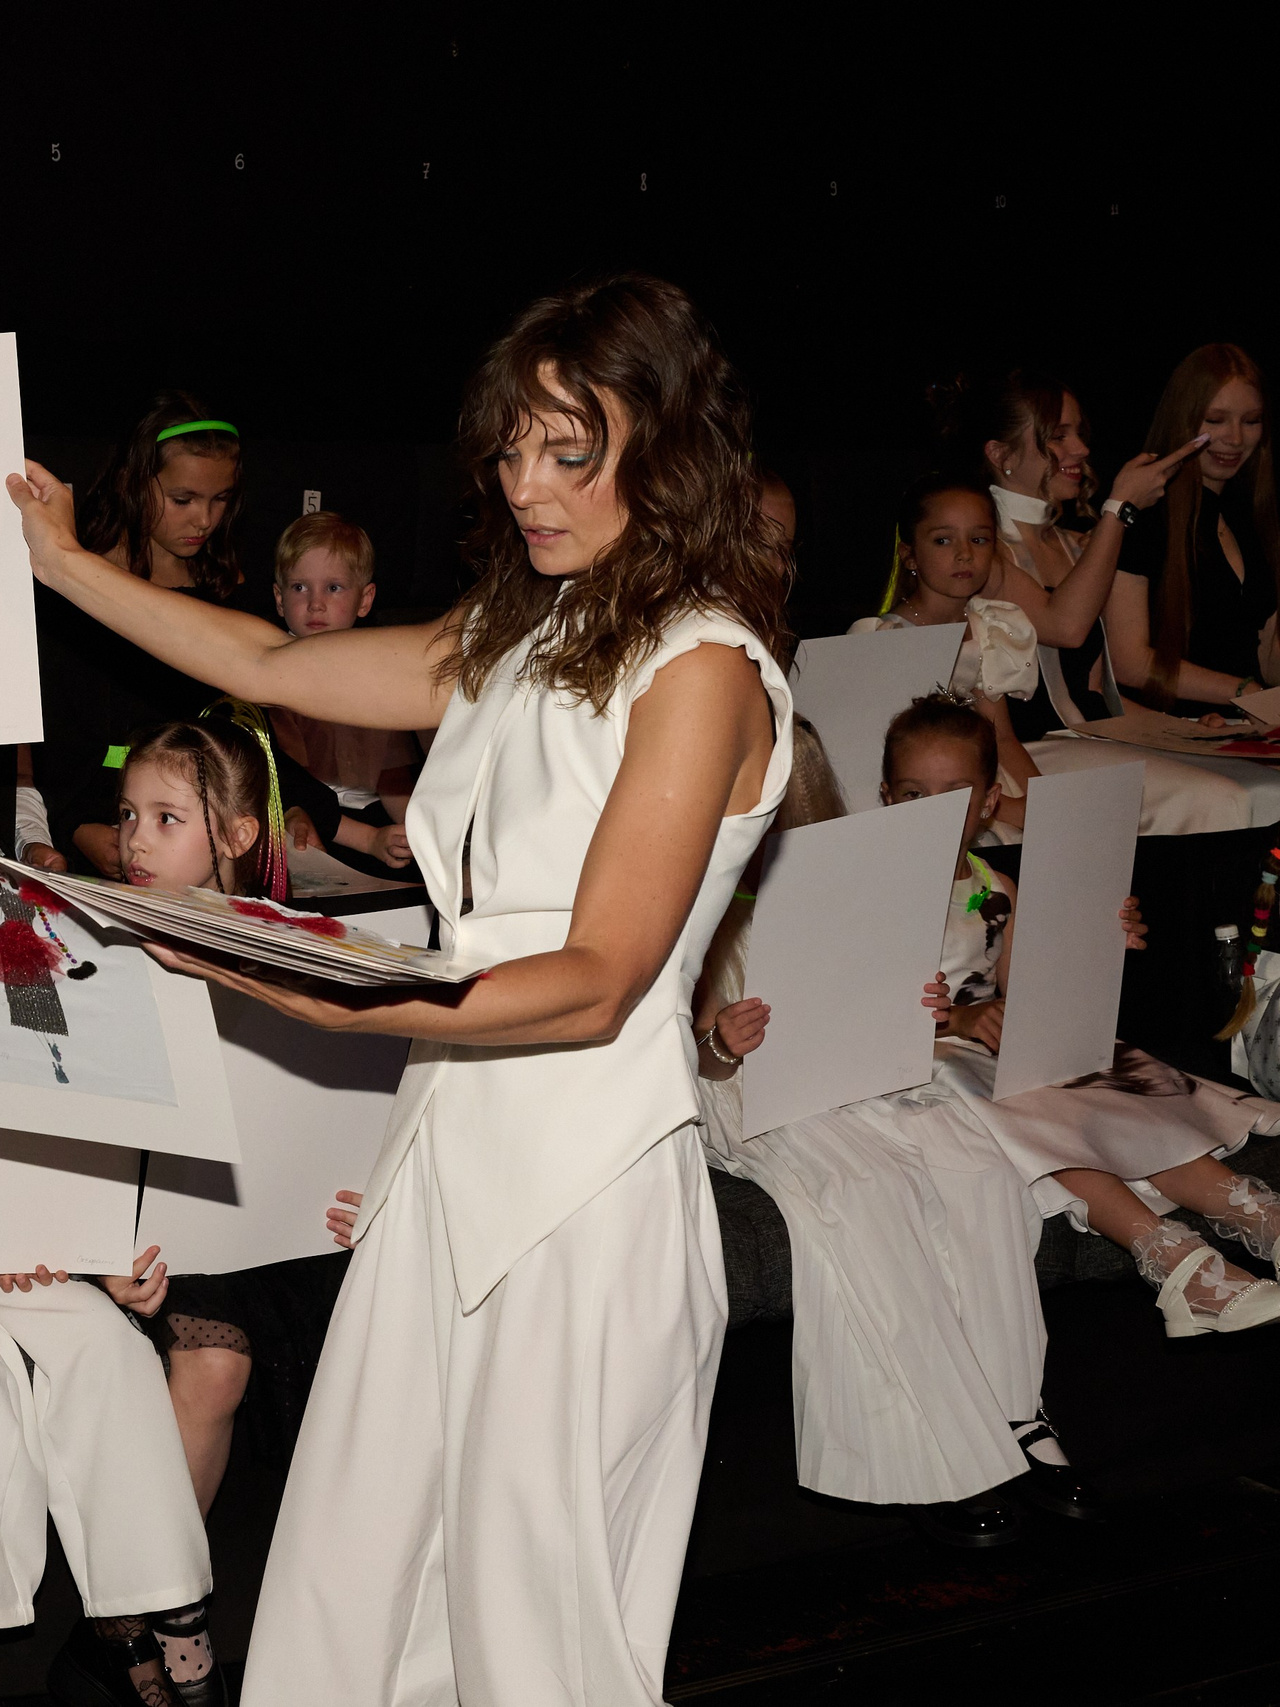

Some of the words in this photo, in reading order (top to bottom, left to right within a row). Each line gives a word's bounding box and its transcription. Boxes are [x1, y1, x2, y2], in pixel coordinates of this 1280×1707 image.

[51, 142, 62, 162] 5
[234, 153, 245, 170] 6
[422, 162, 432, 180] 7
[640, 172, 649, 192] 8
[830, 180, 839, 197] 9
[995, 194, 1008, 209] 10
[306, 496, 317, 514] 5
